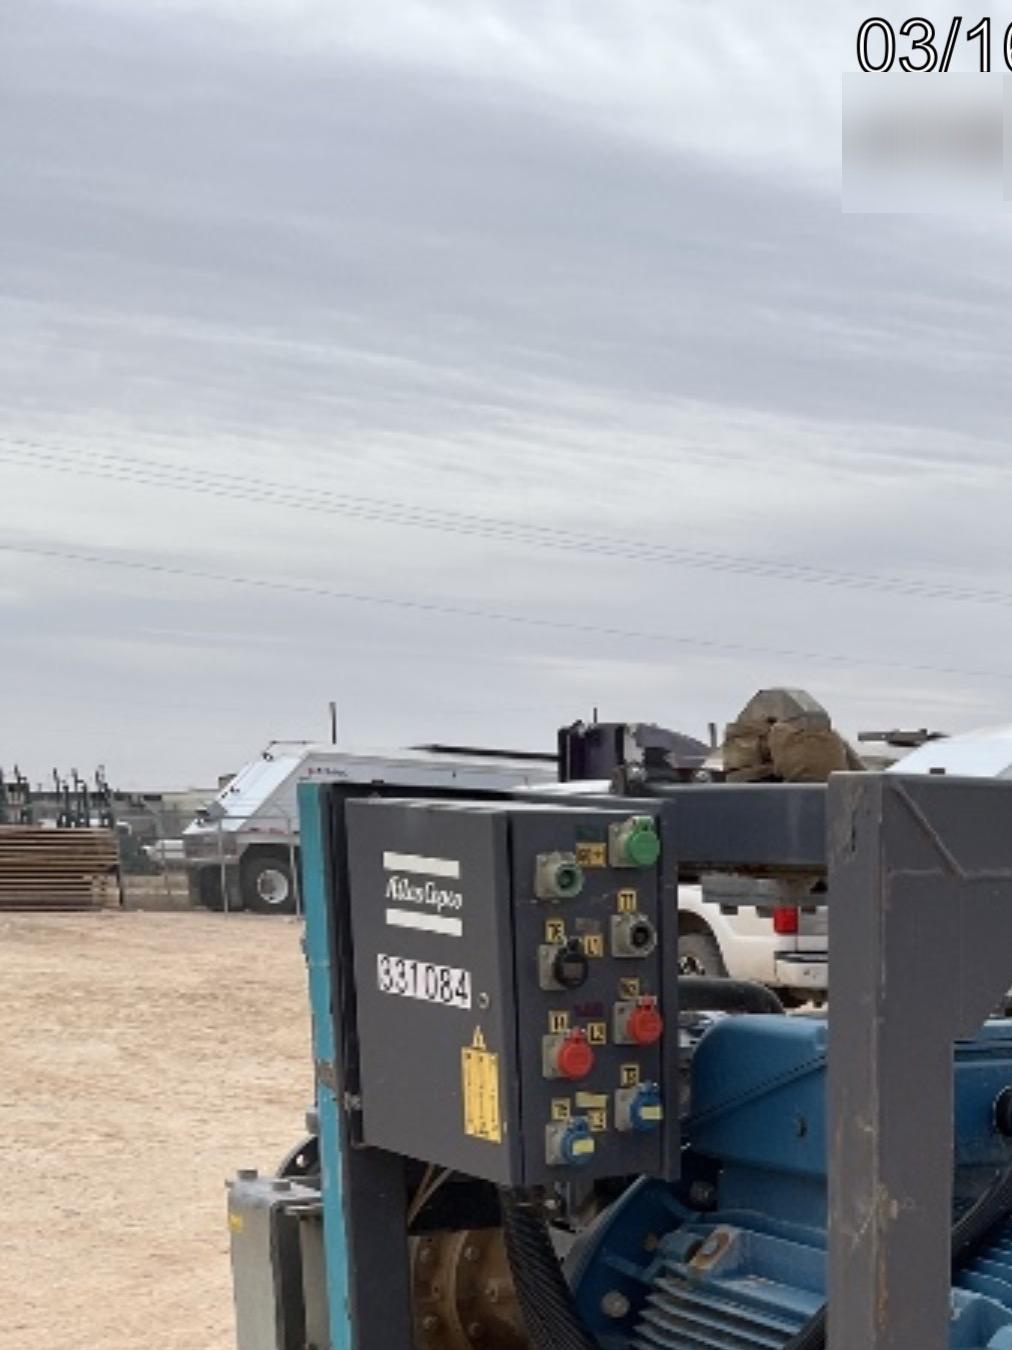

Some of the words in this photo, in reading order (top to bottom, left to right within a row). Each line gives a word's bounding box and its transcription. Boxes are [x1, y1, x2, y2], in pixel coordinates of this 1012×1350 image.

[386, 876, 424, 904] Atlas
[425, 881, 463, 913] Copco
[379, 955, 469, 1004] 331084
